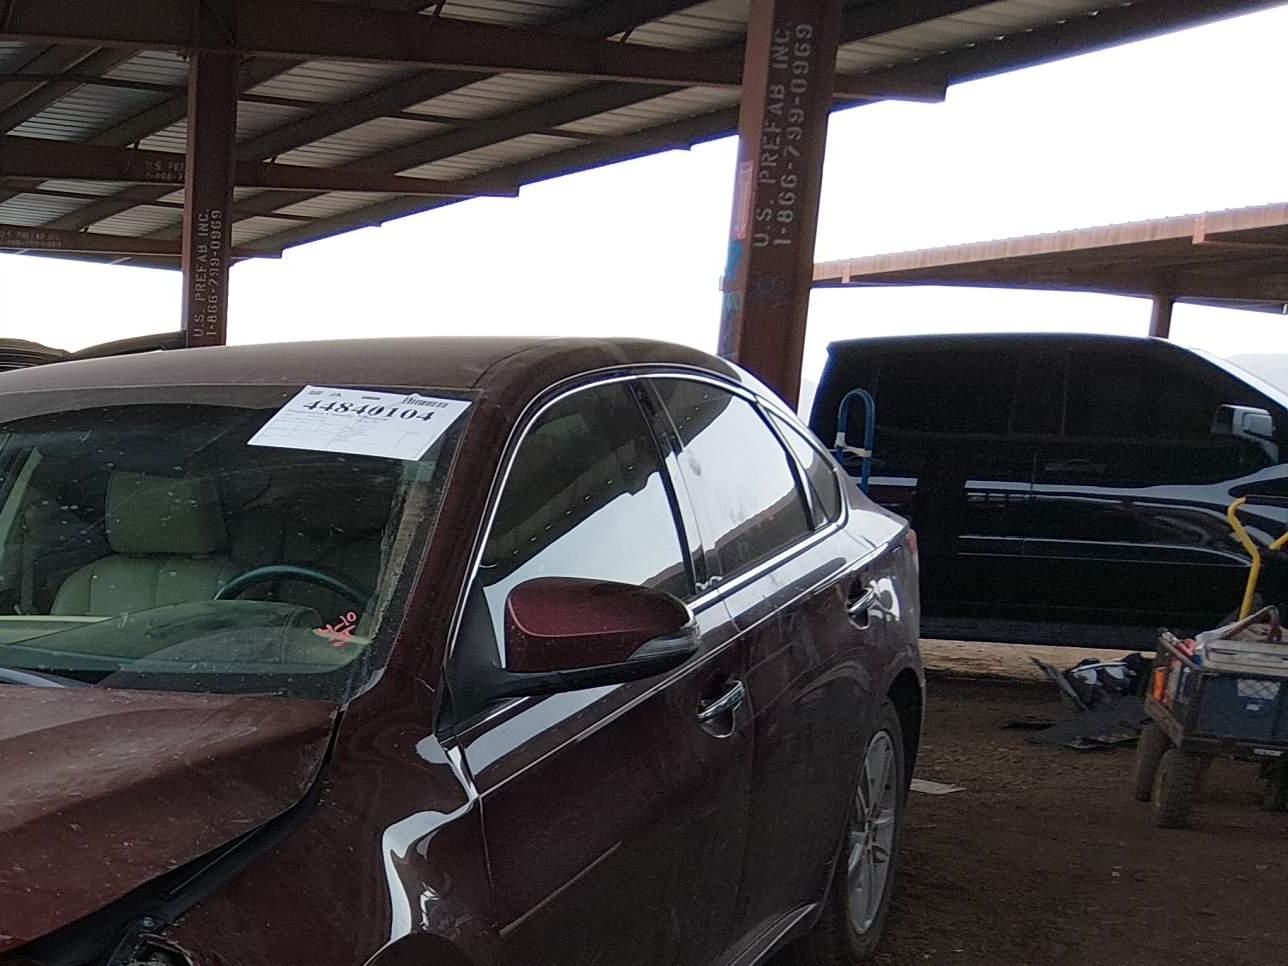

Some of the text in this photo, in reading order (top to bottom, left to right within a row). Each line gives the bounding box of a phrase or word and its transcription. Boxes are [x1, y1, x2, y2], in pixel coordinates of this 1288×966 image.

[772, 20, 793, 70] INC.
[759, 84, 786, 184] PREFAB
[773, 23, 813, 246] 1-866-799-0969
[193, 208, 210, 337] U.S. PREFAB INC.
[206, 209, 222, 337] 1-866-799-0969
[753, 199, 774, 248] U.S.
[303, 400, 436, 421] 44840104
